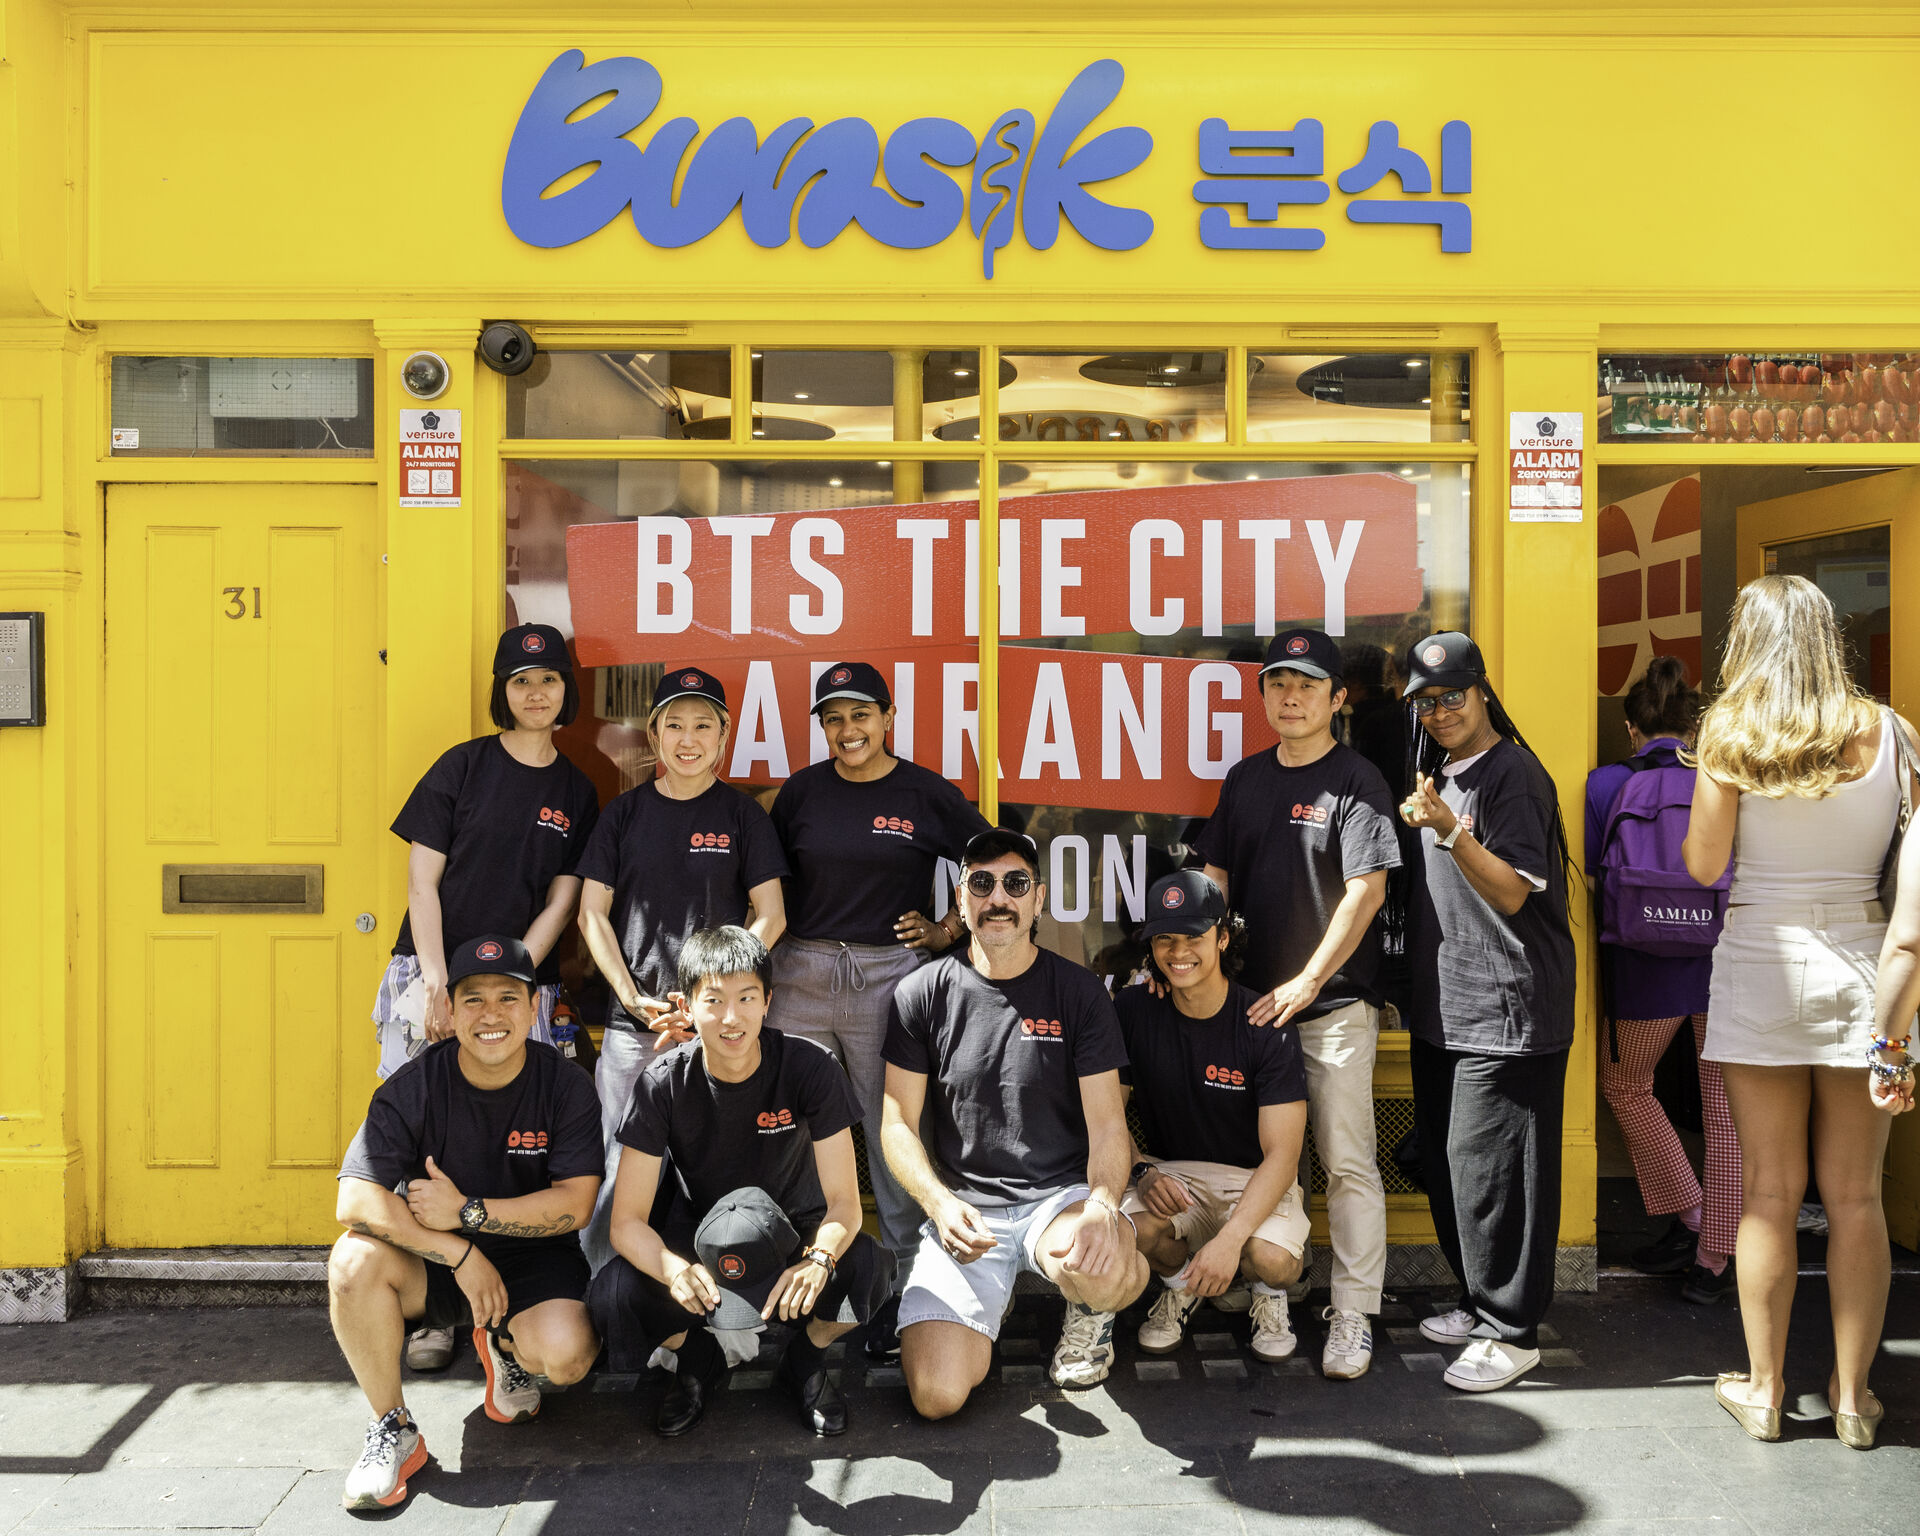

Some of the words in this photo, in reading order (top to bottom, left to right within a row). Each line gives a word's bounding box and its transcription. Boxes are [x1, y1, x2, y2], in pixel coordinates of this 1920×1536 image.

[502, 48, 1154, 280] Bunsik
[1192, 117, 1473, 254] 분식
[406, 431, 455, 439] verisure
[1520, 438, 1573, 447] verisure
[402, 445, 459, 459] ALARM
[1512, 452, 1580, 468] ALARM
[637, 516, 845, 636] BTS
[897, 518, 1086, 637] THE
[1129, 518, 1366, 637] CITY
[223, 587, 262, 619] 31
[1643, 906, 1713, 921] SAMIAD
